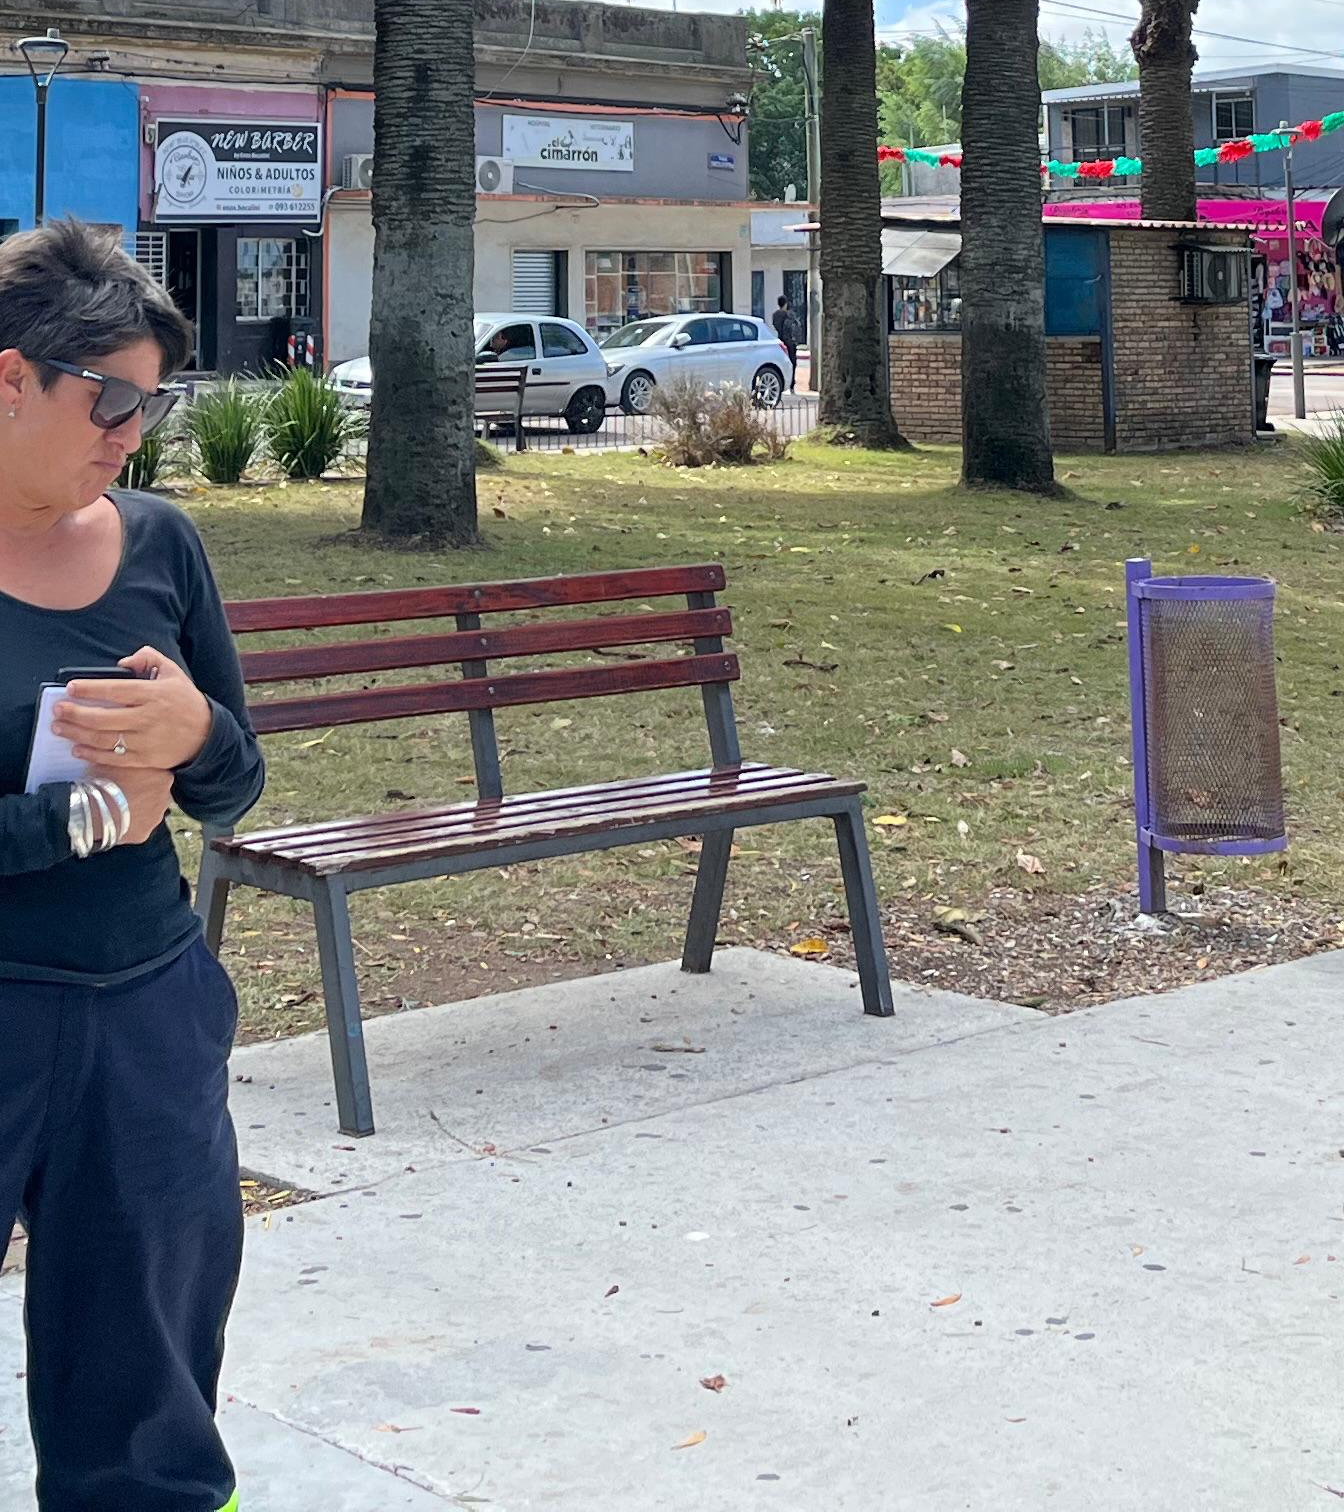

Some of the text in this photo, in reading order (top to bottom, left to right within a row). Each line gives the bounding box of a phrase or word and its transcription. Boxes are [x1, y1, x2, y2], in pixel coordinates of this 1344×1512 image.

[211, 130, 248, 150] NEW
[250, 131, 315, 154] BARBER
[540, 144, 599, 163] cimarrón
[217, 165, 315, 181] NIÑOS & ADULTOS
